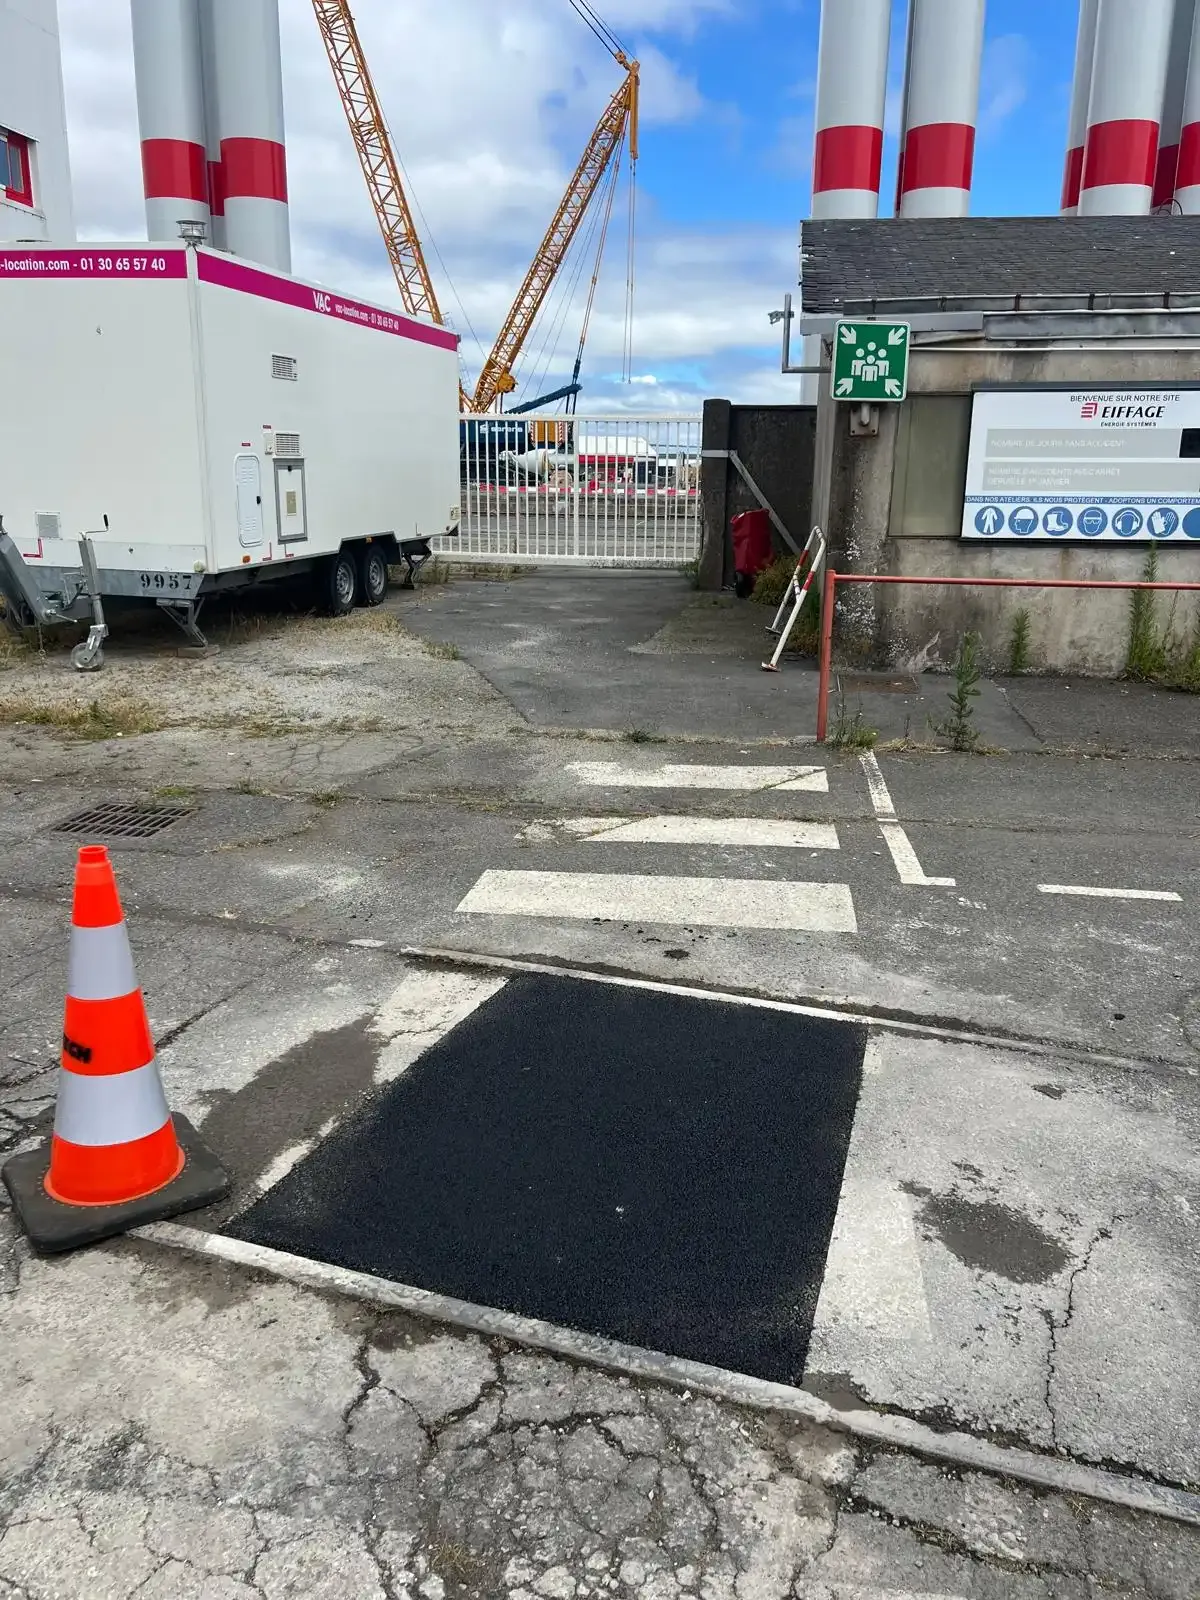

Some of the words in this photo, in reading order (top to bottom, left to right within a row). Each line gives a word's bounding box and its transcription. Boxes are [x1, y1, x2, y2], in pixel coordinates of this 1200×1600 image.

[0, 258, 70, 271] -location.com
[80, 258, 94, 271] 01
[99, 258, 112, 271] 30
[116, 258, 130, 271] 65
[134, 258, 147, 271] 57
[151, 258, 166, 271] 40
[312, 290, 331, 313] VAC
[335, 303, 368, 321] vac-location.com
[371, 312, 377, 323] 01
[377, 314, 383, 326] 30
[388, 318, 394, 329] 57
[394, 320, 399, 330] 40
[1134, 394, 1161, 402] NOTRE
[1163, 394, 1181, 402] SITE
[1101, 405, 1166, 419] EIFFAGE
[1109, 497, 1145, 505] ADOPTONS
[140, 574, 192, 590] 9957
